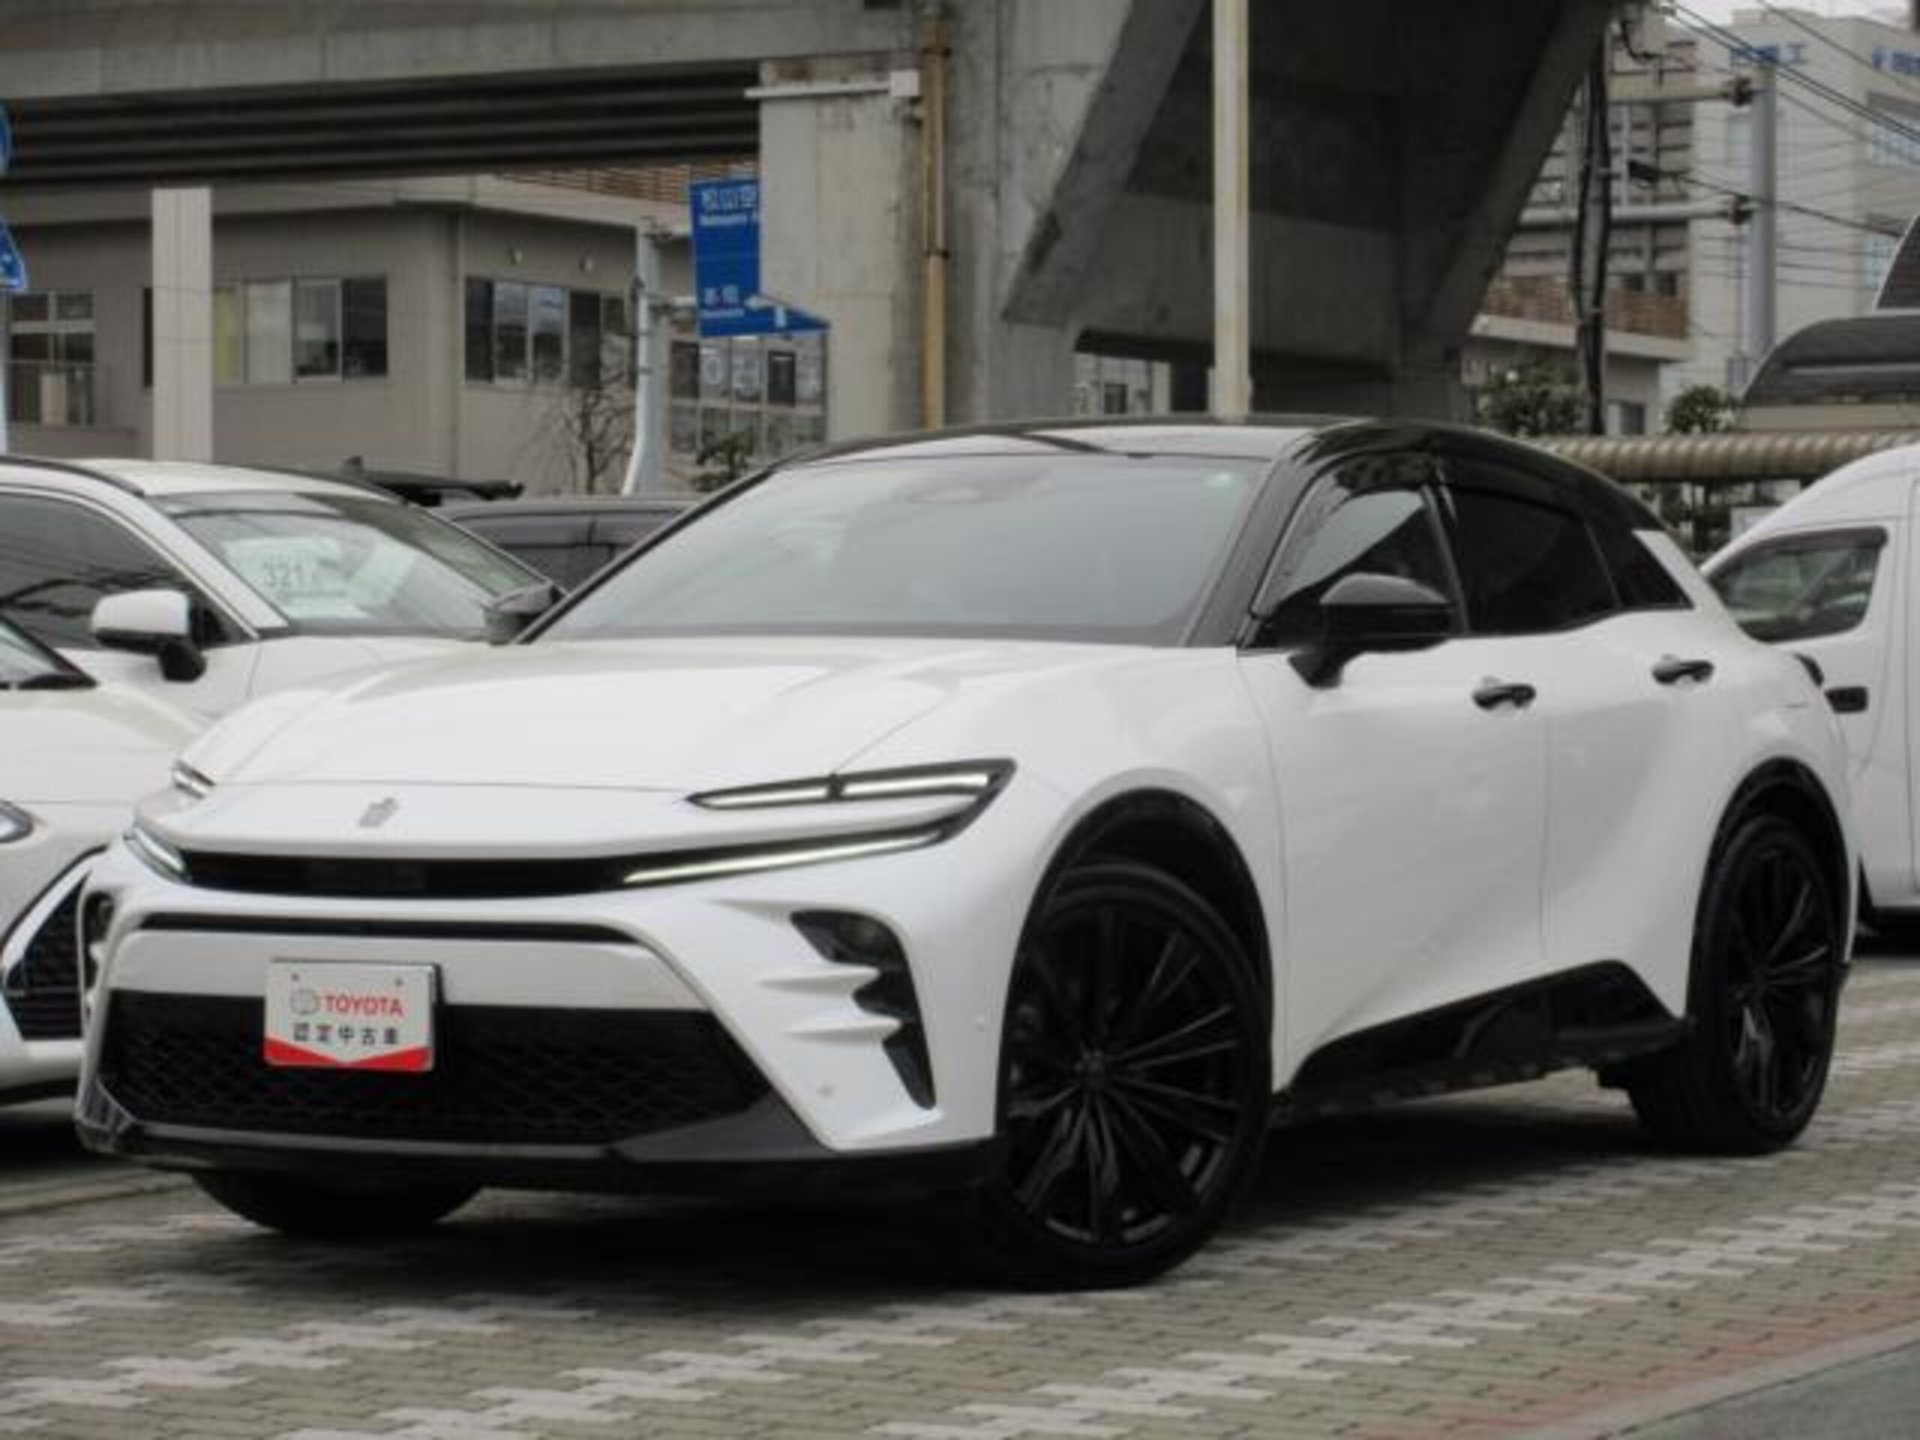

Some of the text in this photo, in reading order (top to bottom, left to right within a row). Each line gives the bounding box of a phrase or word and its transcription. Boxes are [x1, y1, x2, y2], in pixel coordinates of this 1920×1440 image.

[324, 994, 404, 1016] TOYOTA
[293, 1022, 398, 1045] 認定中古車
